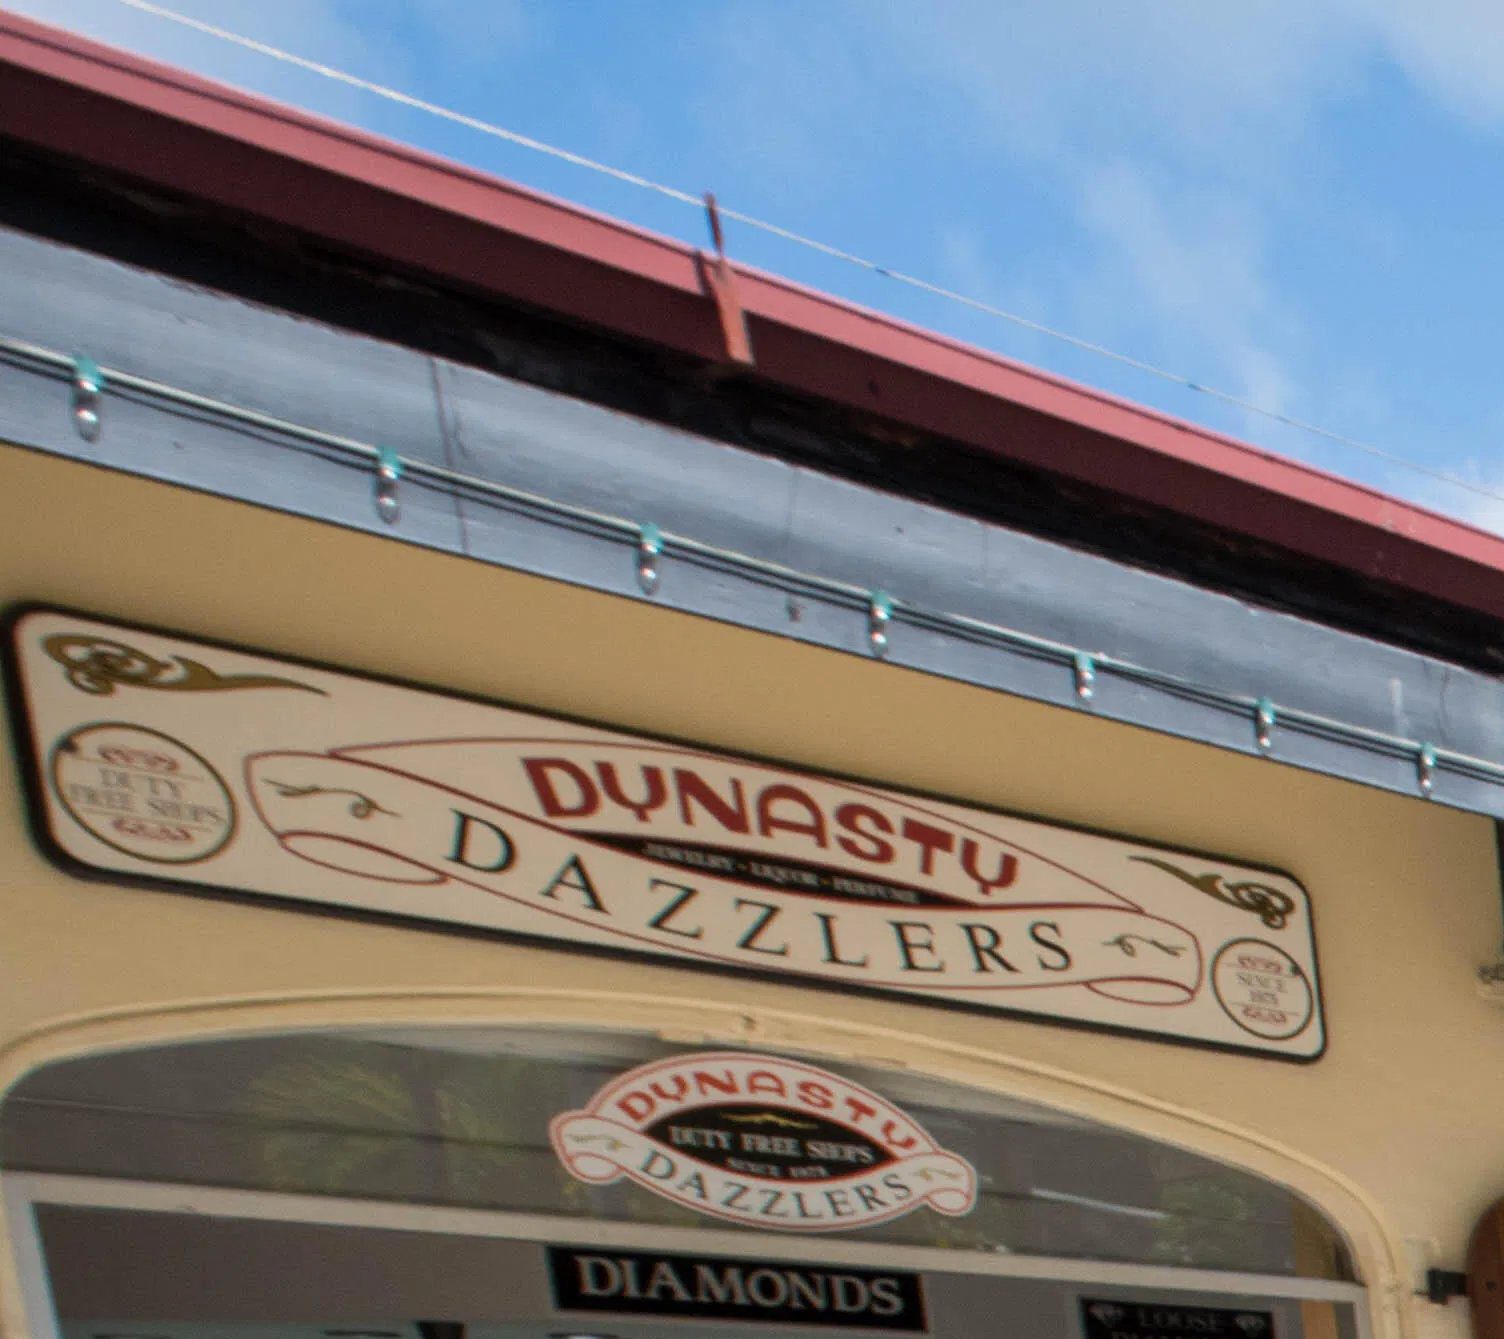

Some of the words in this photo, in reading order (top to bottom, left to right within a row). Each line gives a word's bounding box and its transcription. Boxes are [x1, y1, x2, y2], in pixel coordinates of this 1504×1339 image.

[520, 756, 1020, 895] DYNASTY
[445, 808, 1074, 975] DAZZLERS
[615, 1067, 918, 1151] DYNASTY
[669, 1126, 732, 1149] DUTY
[741, 1133, 800, 1157] FREE
[804, 1140, 877, 1164] SHOPS
[637, 1148, 912, 1219] DAZZLERS
[576, 1255, 905, 1316] DIAMONDS
[1138, 1308, 1225, 1331] LOOSE
